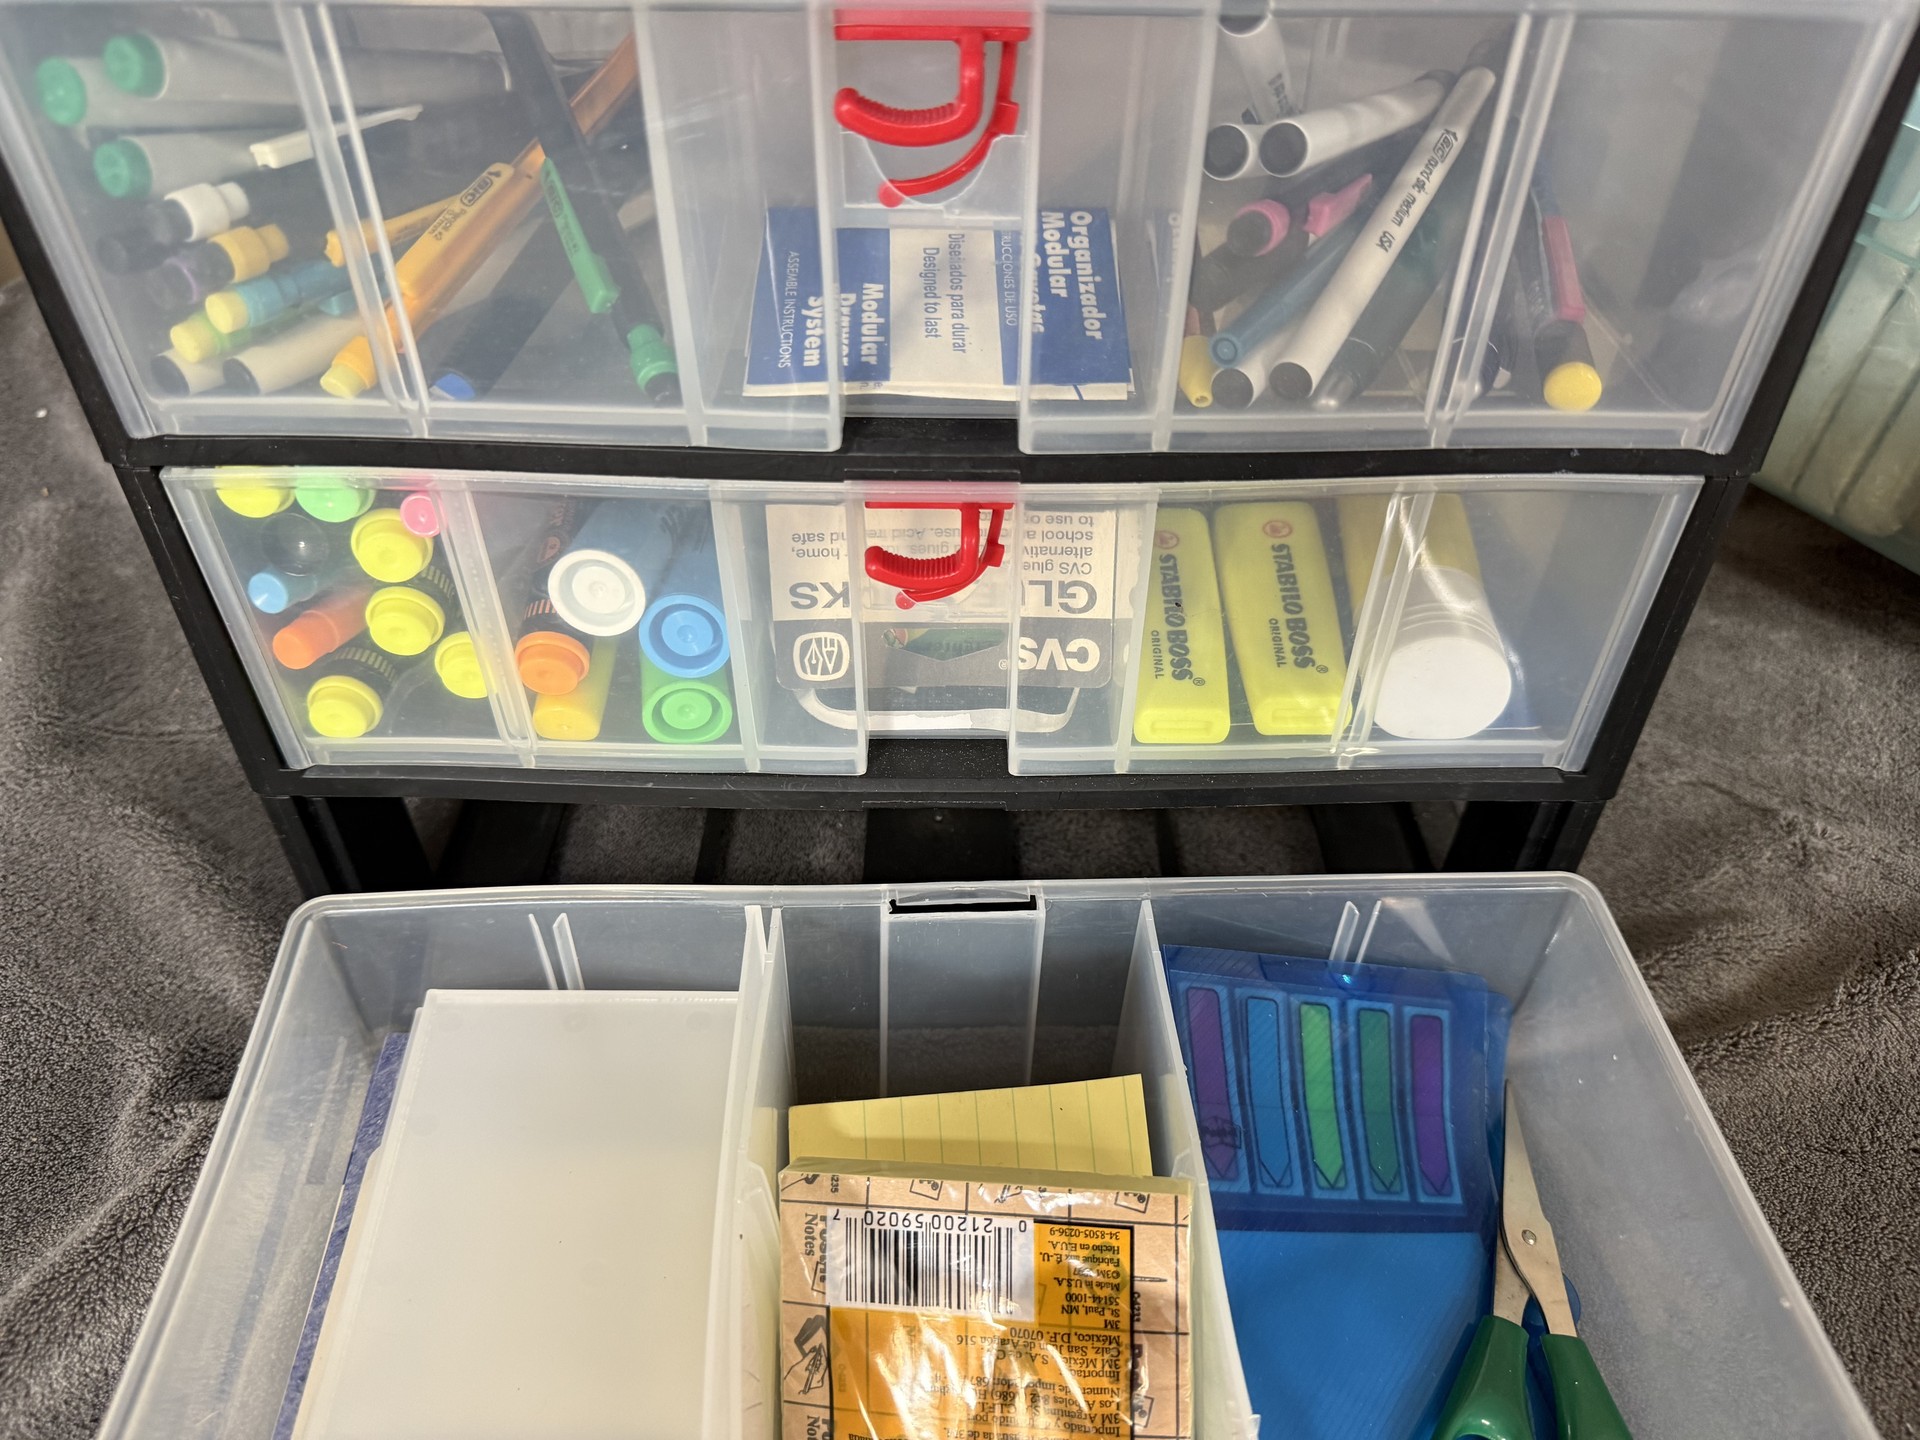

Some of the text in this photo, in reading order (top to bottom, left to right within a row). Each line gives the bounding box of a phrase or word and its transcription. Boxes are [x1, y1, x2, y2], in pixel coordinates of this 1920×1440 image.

[1433, 134, 1452, 161] BIC
[1420, 156, 1439, 183] round
[462, 175, 492, 206] BIC
[1391, 192, 1417, 228] medium
[1376, 230, 1396, 253] USA
[1041, 211, 1072, 298] Modular
[1067, 210, 1107, 340] Organizador
[919, 247, 943, 339] Designed to last
[1003, 291, 1017, 304] DE
[777, 250, 800, 369] ASSEMBLE INSTRUCTIONS
[945, 293, 966, 320] para
[860, 282, 886, 366] Modular
[1004, 307, 1018, 327] USO
[801, 295, 825, 367] System
[951, 322, 970, 353] durar
[1045, 515, 1073, 525] use
[1078, 515, 1095, 527] to
[791, 532, 825, 545] safe
[1041, 530, 1094, 543] school
[791, 546, 841, 559] home,
[1059, 562, 1093, 575] CVS
[1271, 543, 1316, 669] STABILO BOSS
[1159, 553, 1194, 681] STABILO BOSS
[1268, 617, 1288, 668] ORIGINAL
[1018, 636, 1101, 672] CVS
[1151, 629, 1165, 680] ORIGINAL
[832, 1208, 1027, 1233] 0 21200 59020 7
[804, 1212, 819, 1257] Notes
[1049, 1226, 1120, 1241] 34-8505-0236-9
[1091, 1243, 1120, 1255] Hecho
[1081, 1254, 1120, 1268] Fabrique
[1053, 1276, 1120, 1292] Made in U.S.A.
[1065, 1292, 1120, 1306] 55144-1000
[1061, 1303, 1120, 1318] St. Paul, MN
[1103, 1318, 1121, 1330] 3M
[956, 1334, 977, 1346] 516
[1009, 1326, 1120, 1347] México, D.F. 07070
[1023, 1340, 1036, 1352] de
[1040, 1341, 1065, 1352] Jun
[1067, 1344, 1088, 1357] San
[1091, 1346, 1121, 1358] Calz.
[1101, 1358, 1121, 1370] 3M
[1078, 1386, 1120, 1398] Numer
[1101, 1412, 1121, 1424] 3M
